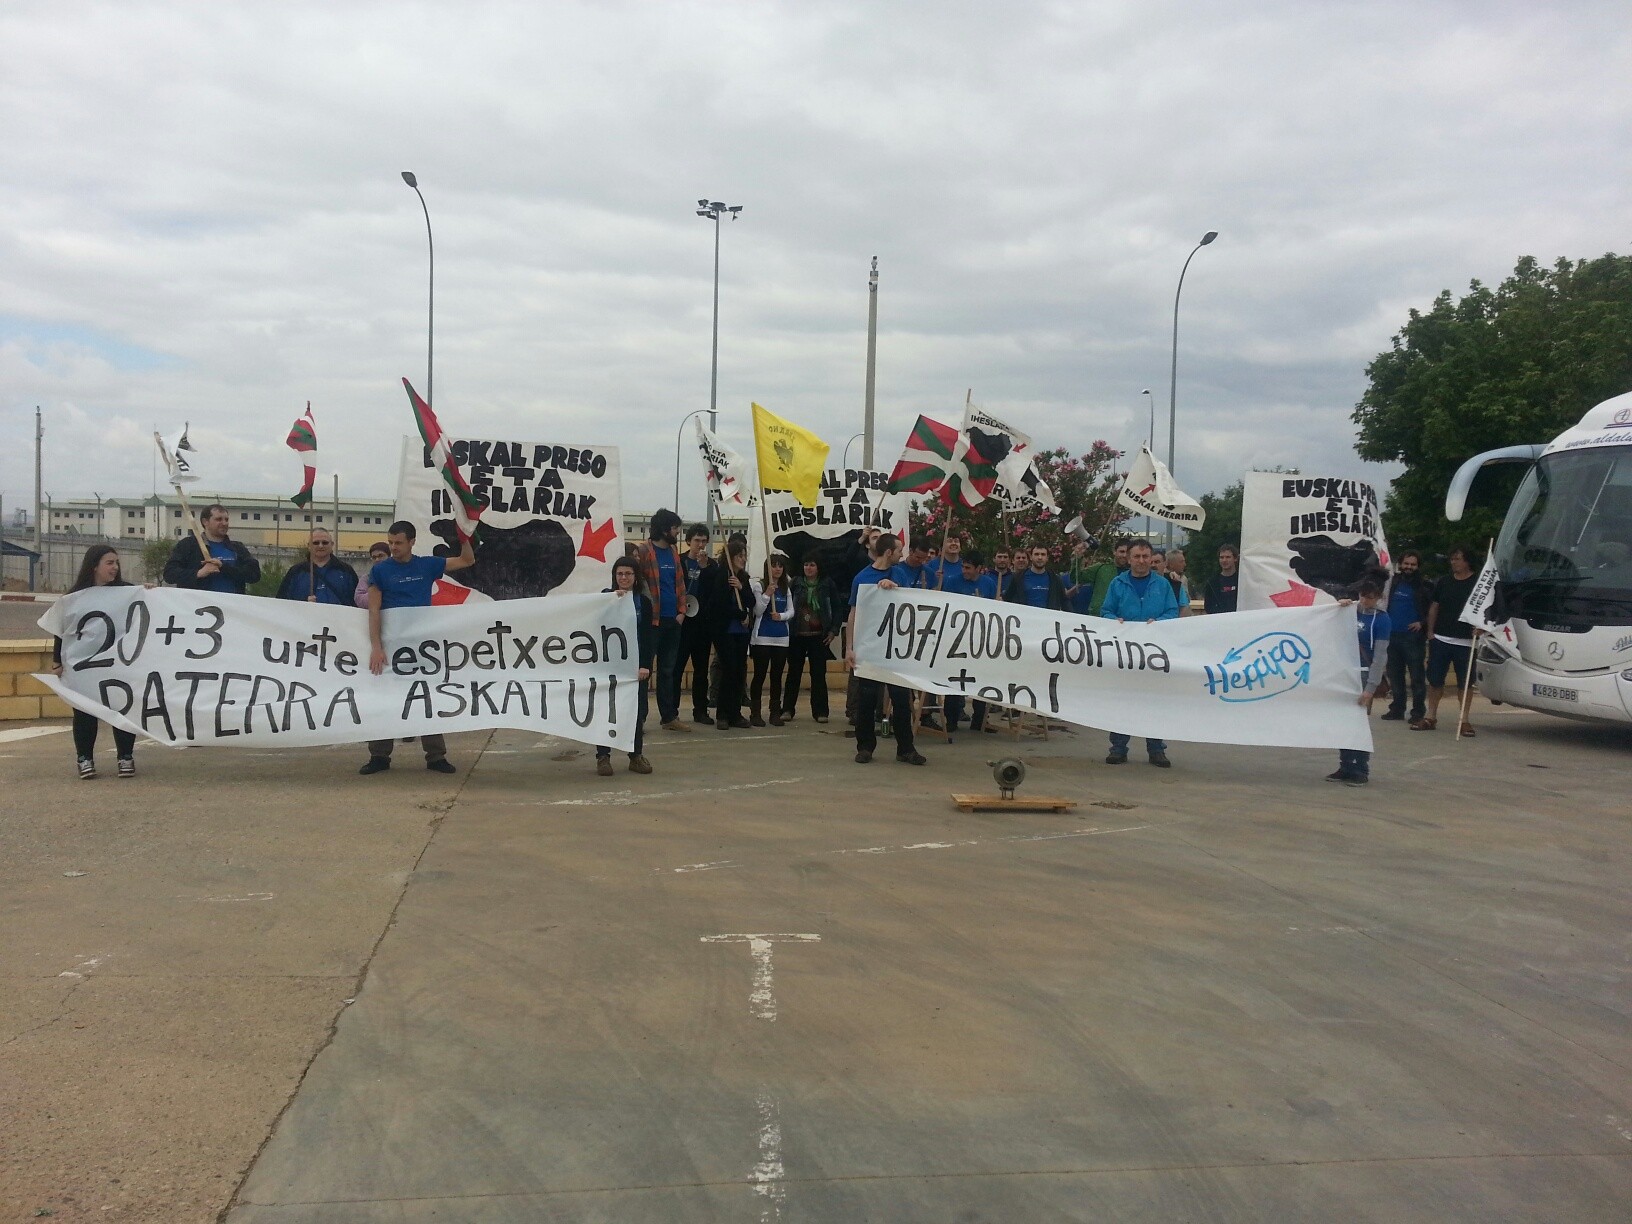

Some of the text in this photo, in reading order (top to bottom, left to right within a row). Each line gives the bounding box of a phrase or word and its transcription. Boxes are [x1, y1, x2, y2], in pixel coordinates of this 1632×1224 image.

[424, 440, 607, 478] ESKAL PRESO
[470, 466, 564, 489] ETA
[845, 469, 889, 493] PRES
[1283, 478, 1358, 499] EUSKAL
[431, 484, 597, 520] ISLARIAK
[771, 503, 894, 533] IHESLARIAK
[1124, 487, 1199, 521] EUSKAL HERRIRA
[1326, 498, 1372, 519] ETA
[1472, 568, 1499, 615] IHESLARIAK
[72, 601, 629, 683] 20+3 urte espetxean
[876, 602, 1171, 674] 197/2006 dotrina
[401, 674, 619, 739] ASKATU!
